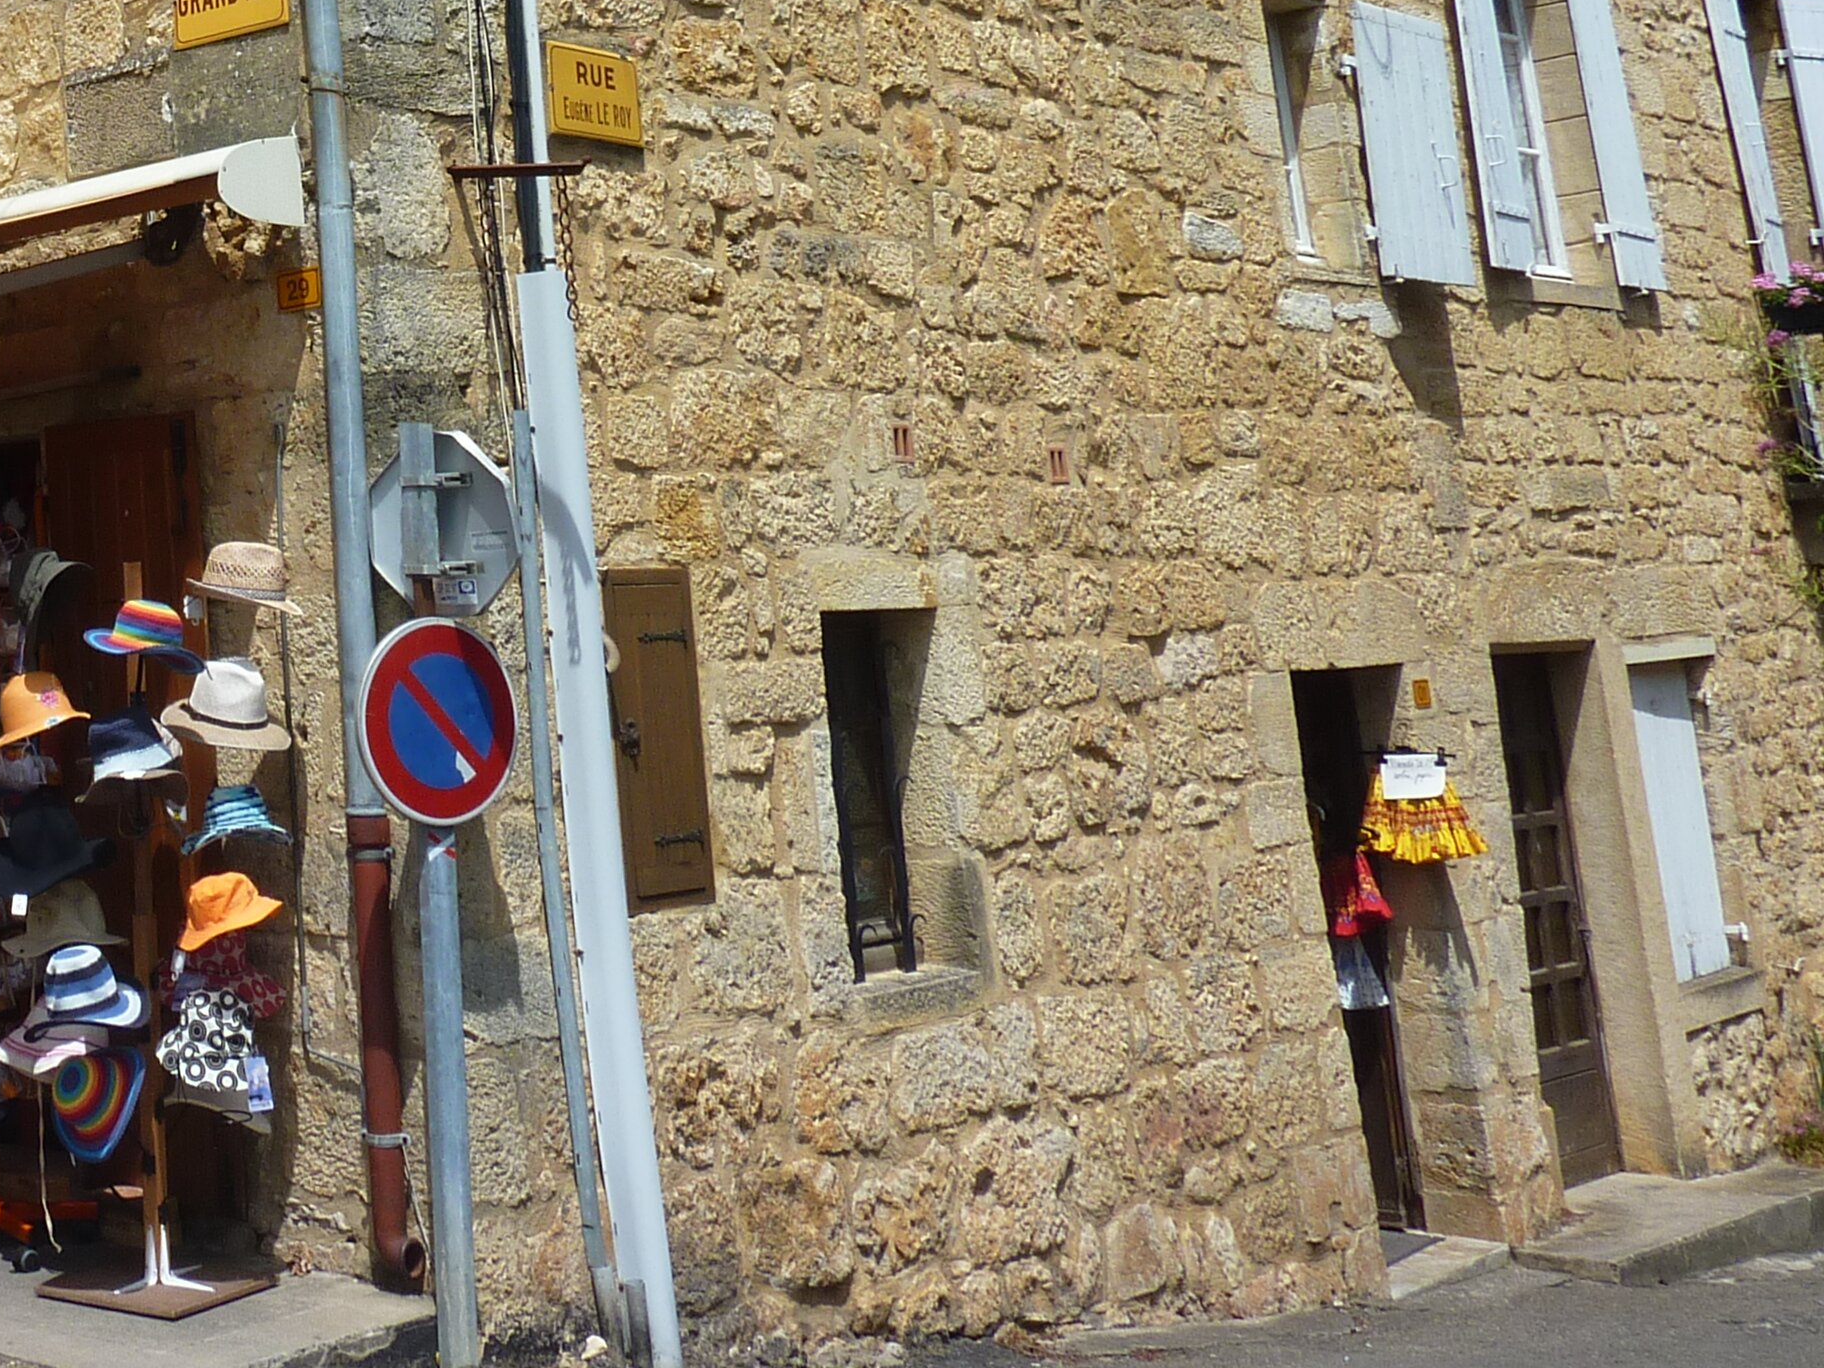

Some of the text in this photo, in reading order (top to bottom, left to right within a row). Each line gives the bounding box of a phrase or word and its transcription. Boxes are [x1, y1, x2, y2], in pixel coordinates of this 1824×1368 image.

[576, 60, 617, 91] RUE
[596, 101, 610, 126] LE
[613, 104, 632, 130] ROY
[287, 277, 310, 301] 29
